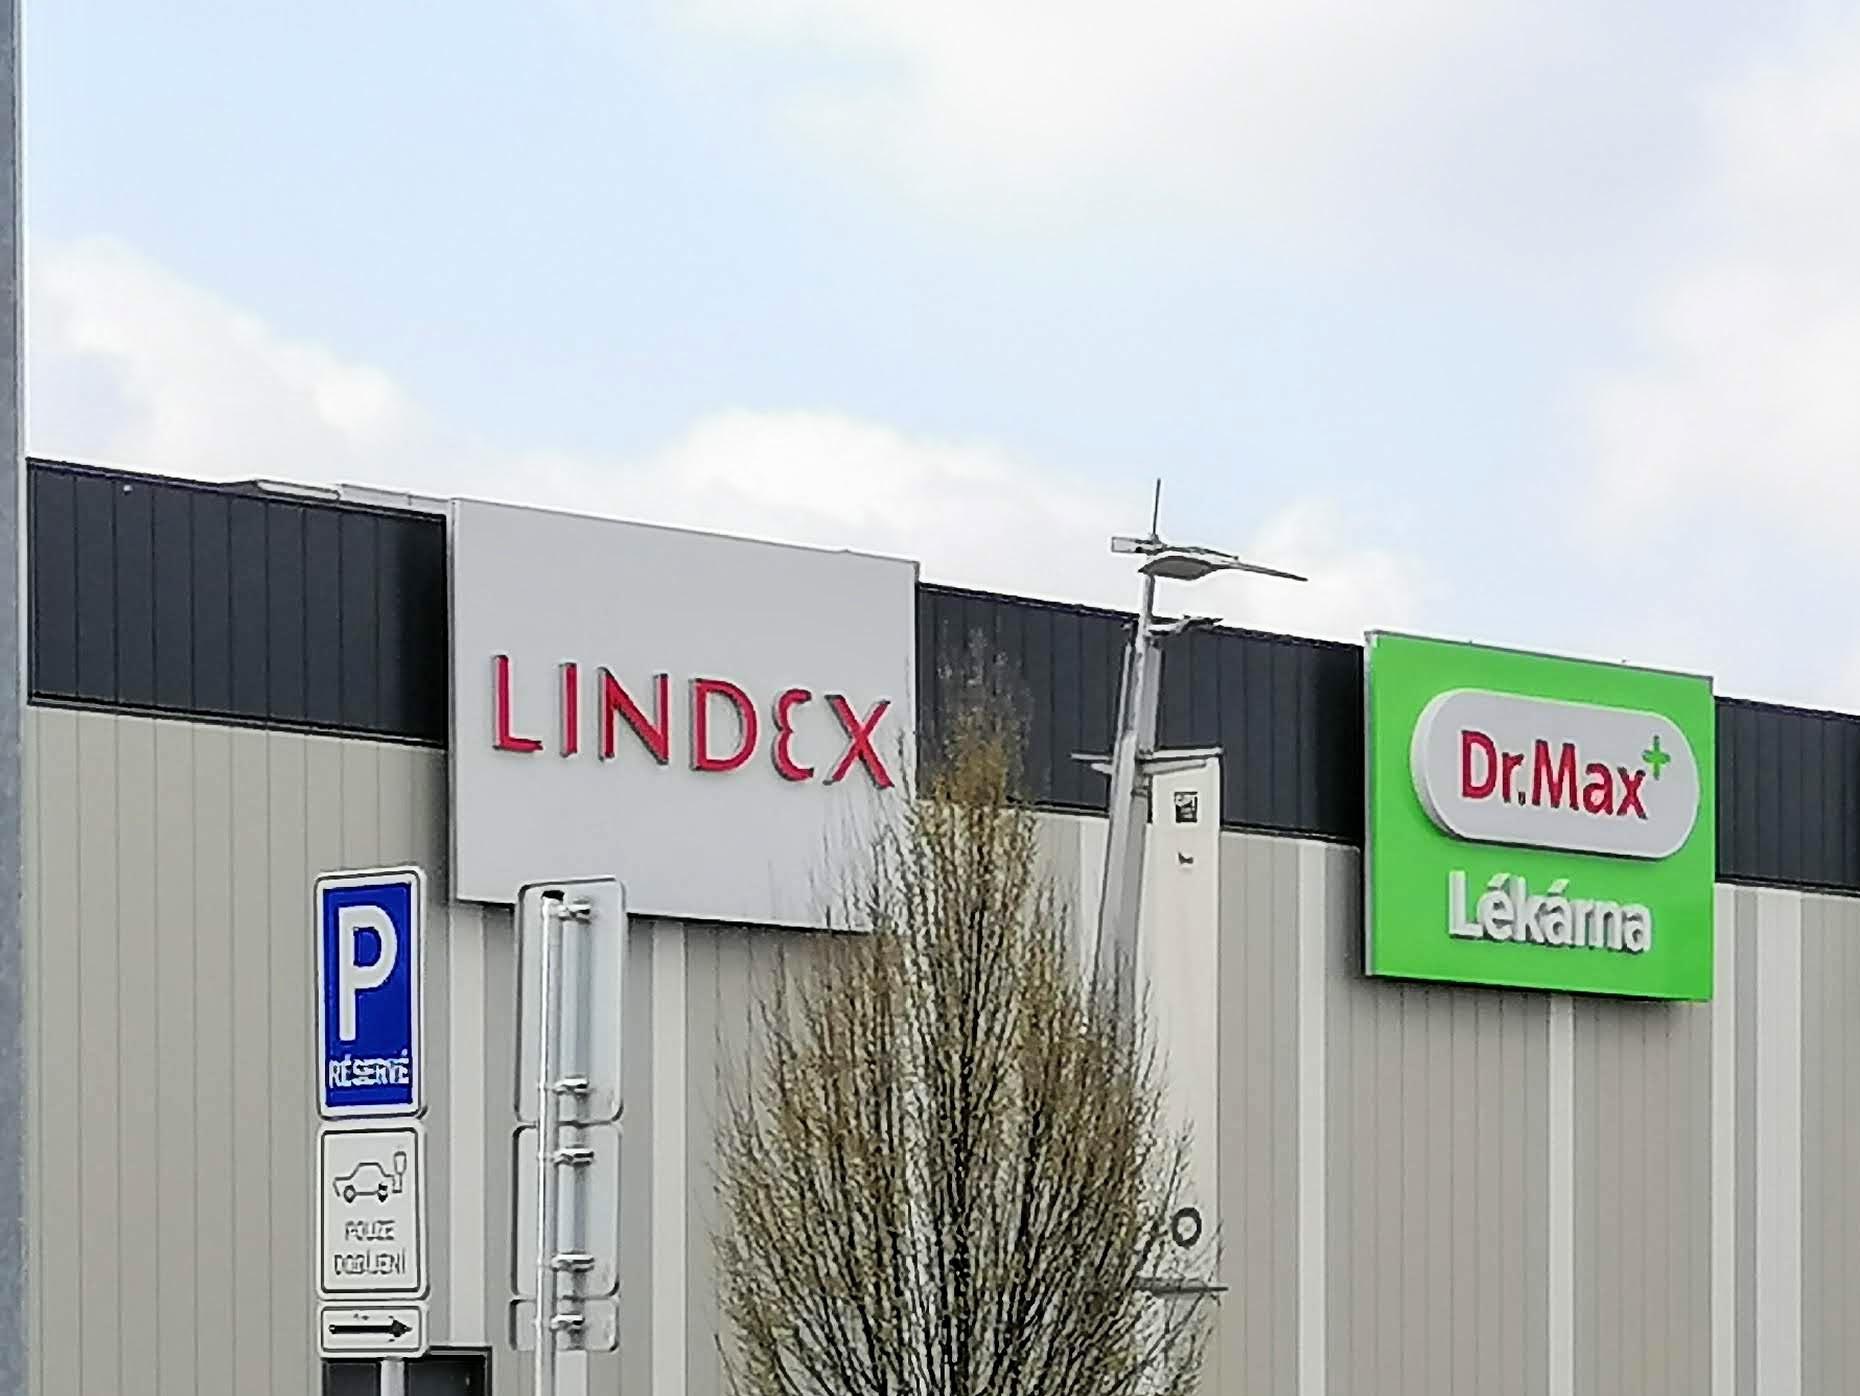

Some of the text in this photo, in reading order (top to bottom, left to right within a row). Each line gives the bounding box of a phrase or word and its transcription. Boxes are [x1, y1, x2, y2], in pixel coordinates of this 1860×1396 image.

[493, 655, 895, 789] LINDEX
[338, 904, 398, 1041] P
[1448, 870, 1651, 954] Lékárna
